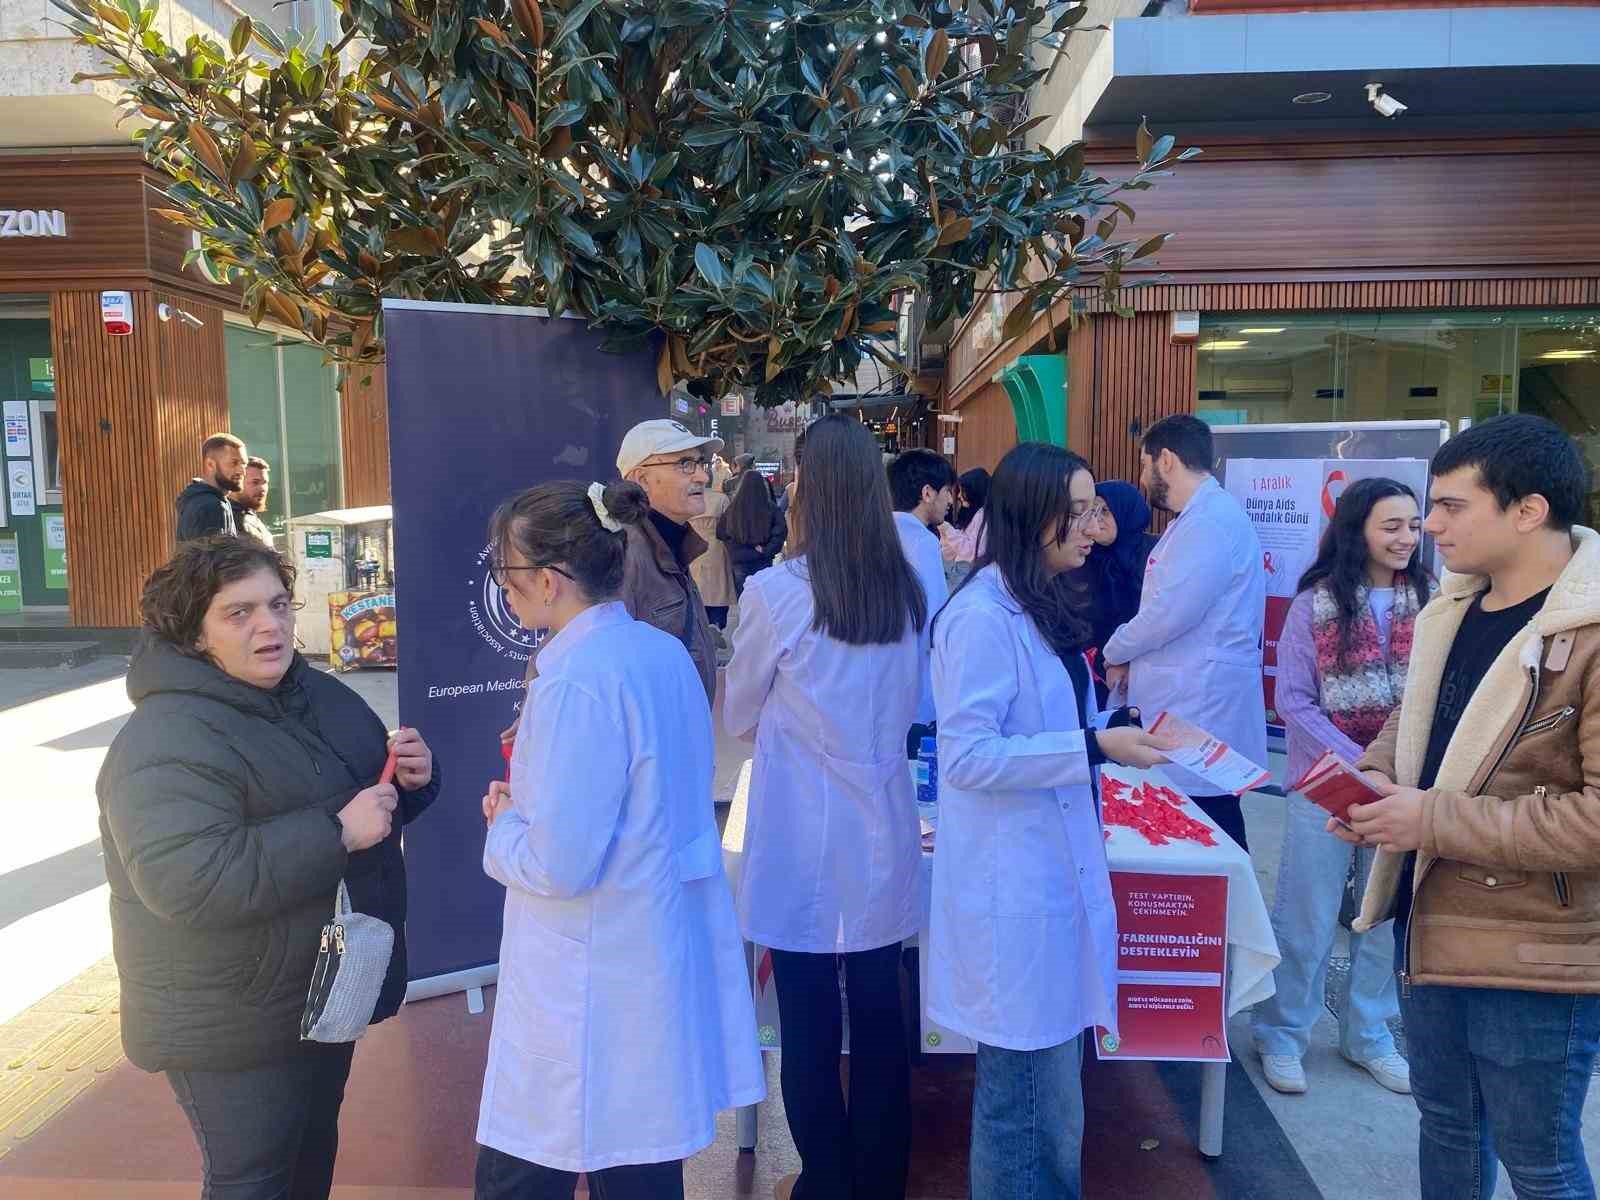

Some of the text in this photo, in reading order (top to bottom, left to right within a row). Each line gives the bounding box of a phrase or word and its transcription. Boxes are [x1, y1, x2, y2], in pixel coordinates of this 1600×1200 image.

[0, 209, 66, 237] ZON
[1246, 497, 1296, 512] Dünya Aids
[1284, 511, 1310, 524] Günü
[340, 594, 395, 620] KESTANE
[469, 606, 505, 653] Association
[428, 682, 483, 698] European
[1128, 892, 1195, 902] TEST YAPTIRIN.
[1123, 932, 1222, 946] FARKINDALIĞINI
[1120, 945, 1200, 958] DESTEKLEYİN
